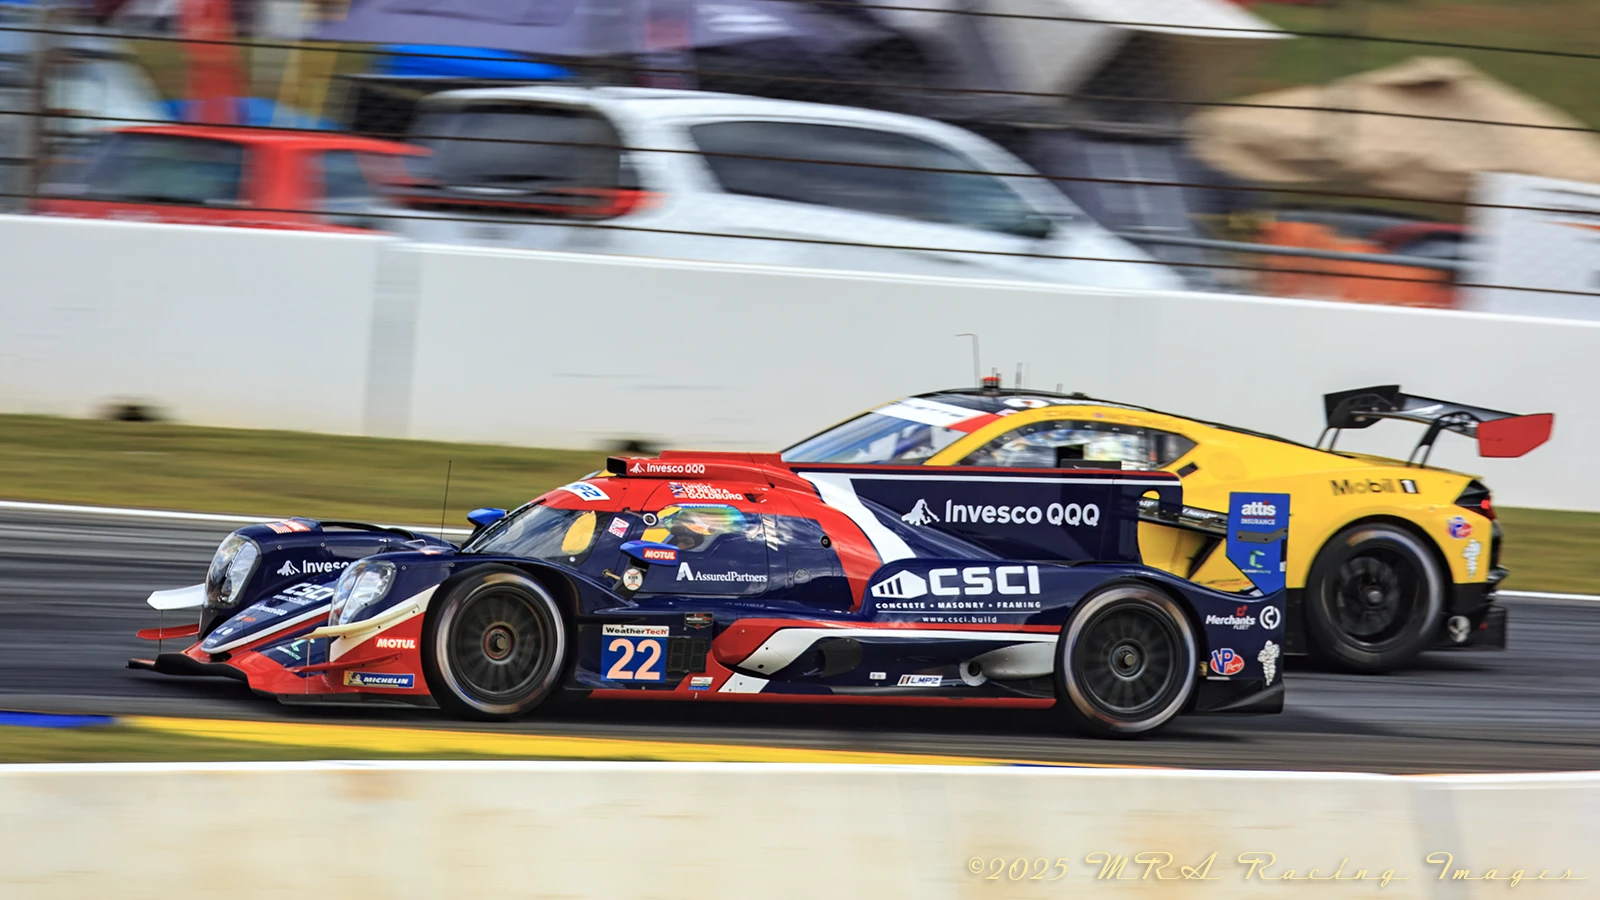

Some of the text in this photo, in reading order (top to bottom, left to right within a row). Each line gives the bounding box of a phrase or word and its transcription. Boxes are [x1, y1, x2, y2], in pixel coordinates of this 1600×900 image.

[647, 463, 706, 475] Invesco QQQ
[1329, 478, 1420, 496] Mobil 1
[687, 491, 744, 501] GOLDBURG
[945, 499, 1100, 526] Invesco QQQ
[1241, 500, 1276, 516] attis
[1240, 518, 1276, 526] INSURANCE
[644, 550, 675, 560] MOTUL
[303, 560, 349, 573] Invesc
[695, 570, 768, 583] AssuredPartners
[928, 565, 1041, 596] CSCI
[1205, 614, 1257, 626] Merchants
[605, 626, 667, 635] WeatherTech
[376, 638, 416, 649] MOTUL
[606, 638, 662, 681] 22
[1211, 648, 1235, 674] VP
[363, 676, 409, 685] MICHELIN
[910, 677, 940, 685] LMP2
